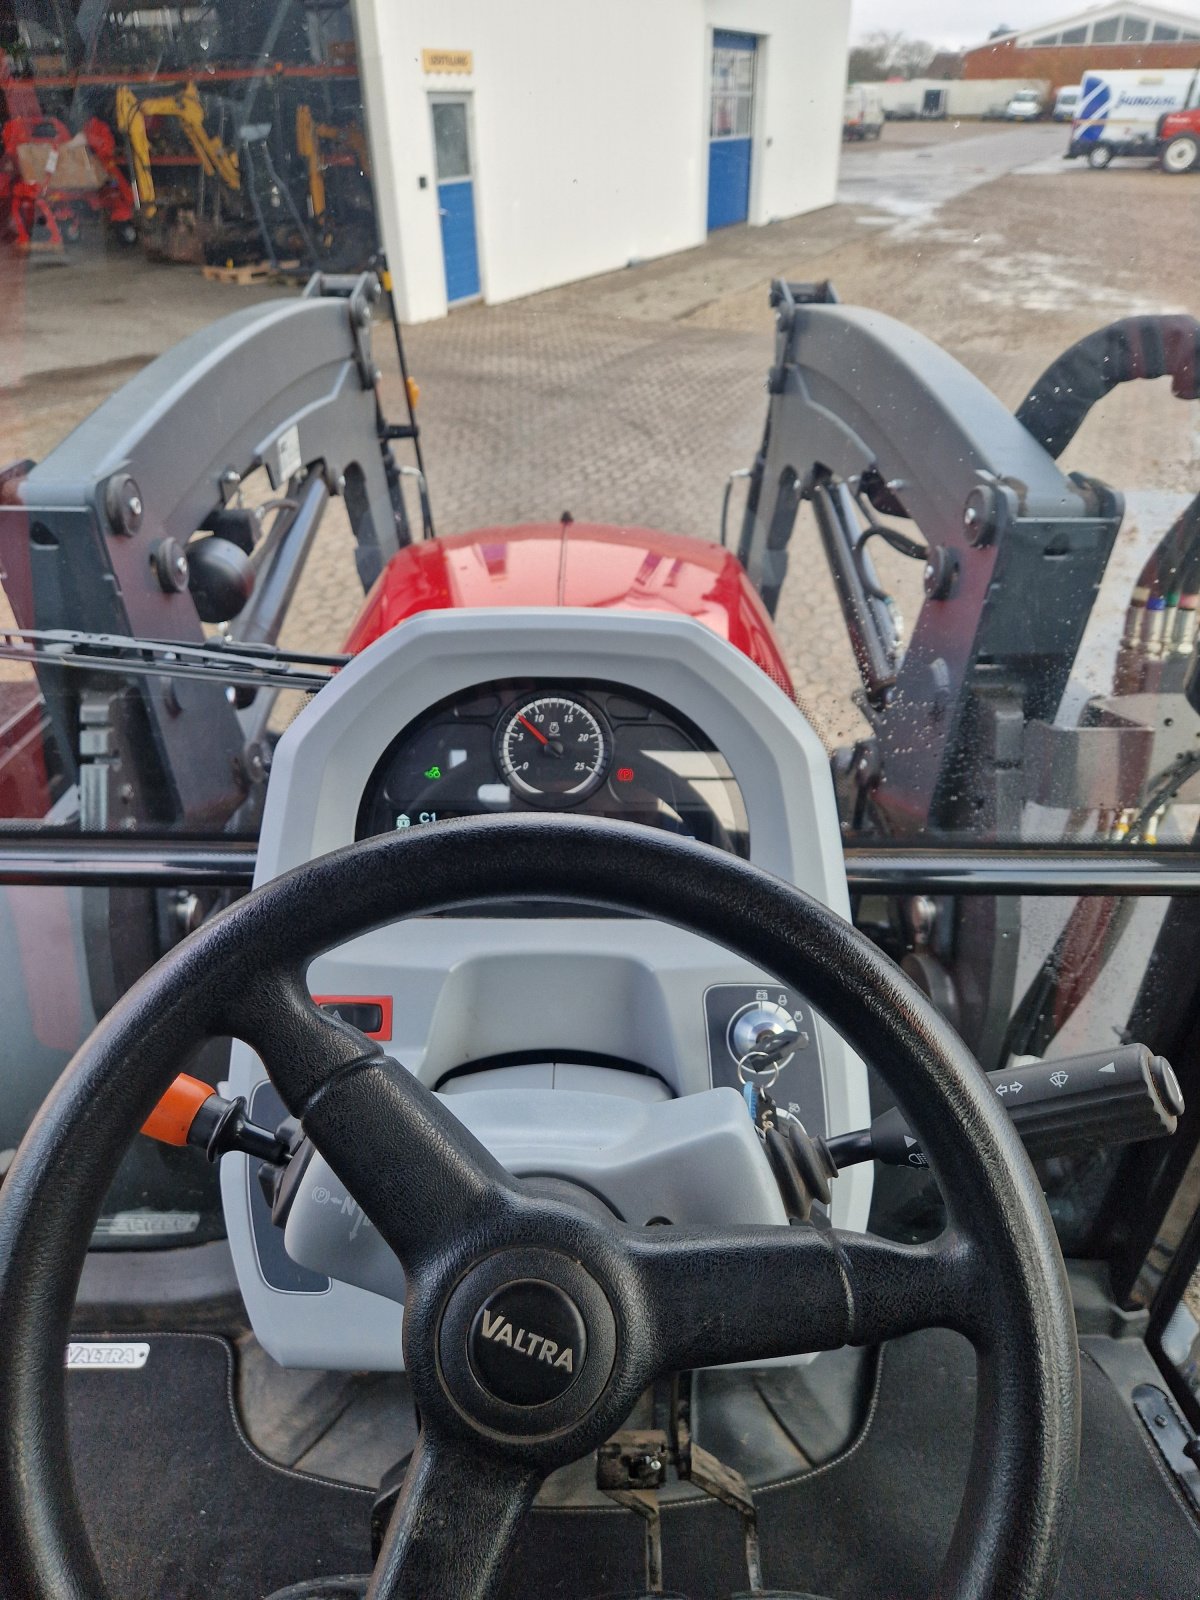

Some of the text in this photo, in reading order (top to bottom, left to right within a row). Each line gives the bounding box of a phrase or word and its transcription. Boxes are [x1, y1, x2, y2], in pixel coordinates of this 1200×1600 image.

[534, 714, 544, 722] 10
[564, 714, 573, 722] 15
[518, 733, 524, 741] 5
[578, 734, 588, 742] 20
[522, 762, 529, 770] 0
[574, 762, 585, 770] 25
[419, 812, 436, 823] C1
[340, 1196, 357, 1217] N
[481, 1309, 573, 1374] VALTRA
